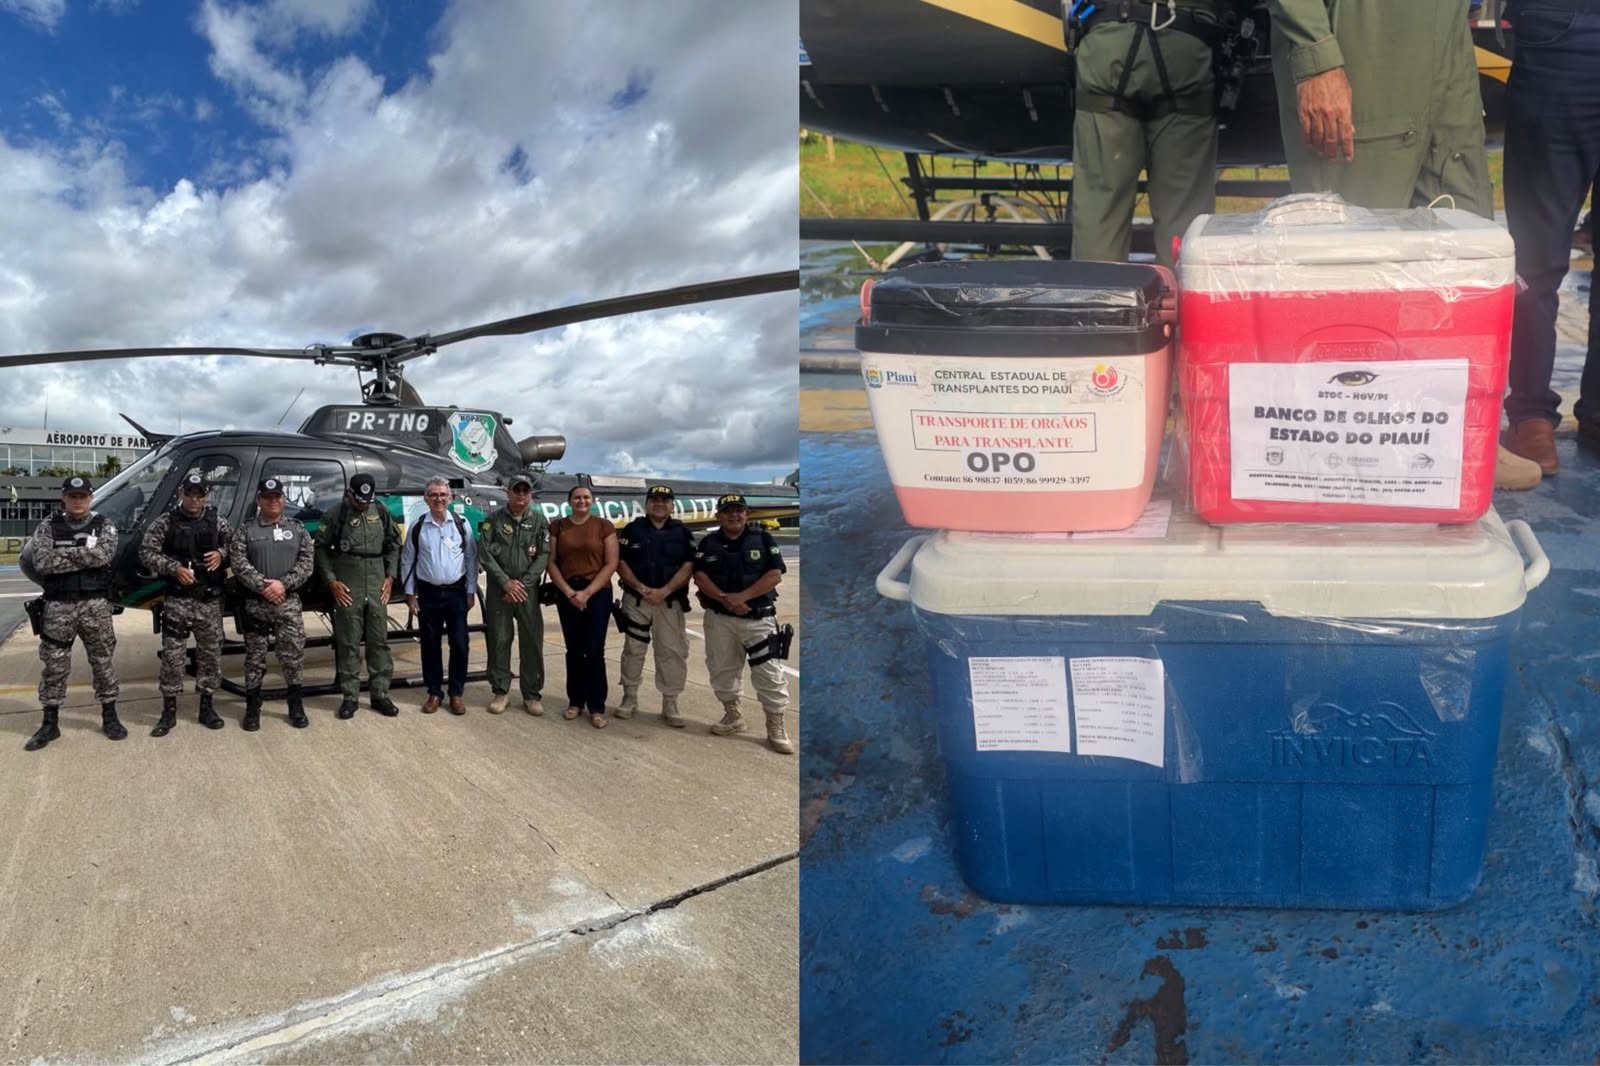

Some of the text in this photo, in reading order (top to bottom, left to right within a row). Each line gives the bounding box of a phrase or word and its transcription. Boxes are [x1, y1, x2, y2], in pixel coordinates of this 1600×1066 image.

[886, 370, 917, 383] Piauí
[934, 369, 1067, 381] CENTRAL ESTADUAL DE
[931, 383, 1019, 394] TRANSPLANTES
[1022, 385, 1039, 394] DO
[1042, 383, 1072, 395] PIAUÍ
[345, 411, 430, 432] PR-TNG
[917, 415, 1088, 430] TRANSPORTE DE ORGÃOS
[1253, 406, 1449, 425] BANCO DE OLHOS DO
[46, 433, 106, 446] AEROPORTO
[111, 436, 123, 447] DE
[934, 435, 1073, 449] PARA TRANSPLANTE
[1269, 427, 1430, 446] ESTADO DO PIAUÍ
[966, 452, 1036, 473] OPO
[924, 473, 961, 483] Contato:
[962, 475, 974, 484] 86
[1271, 736, 1432, 768] INVICTA
